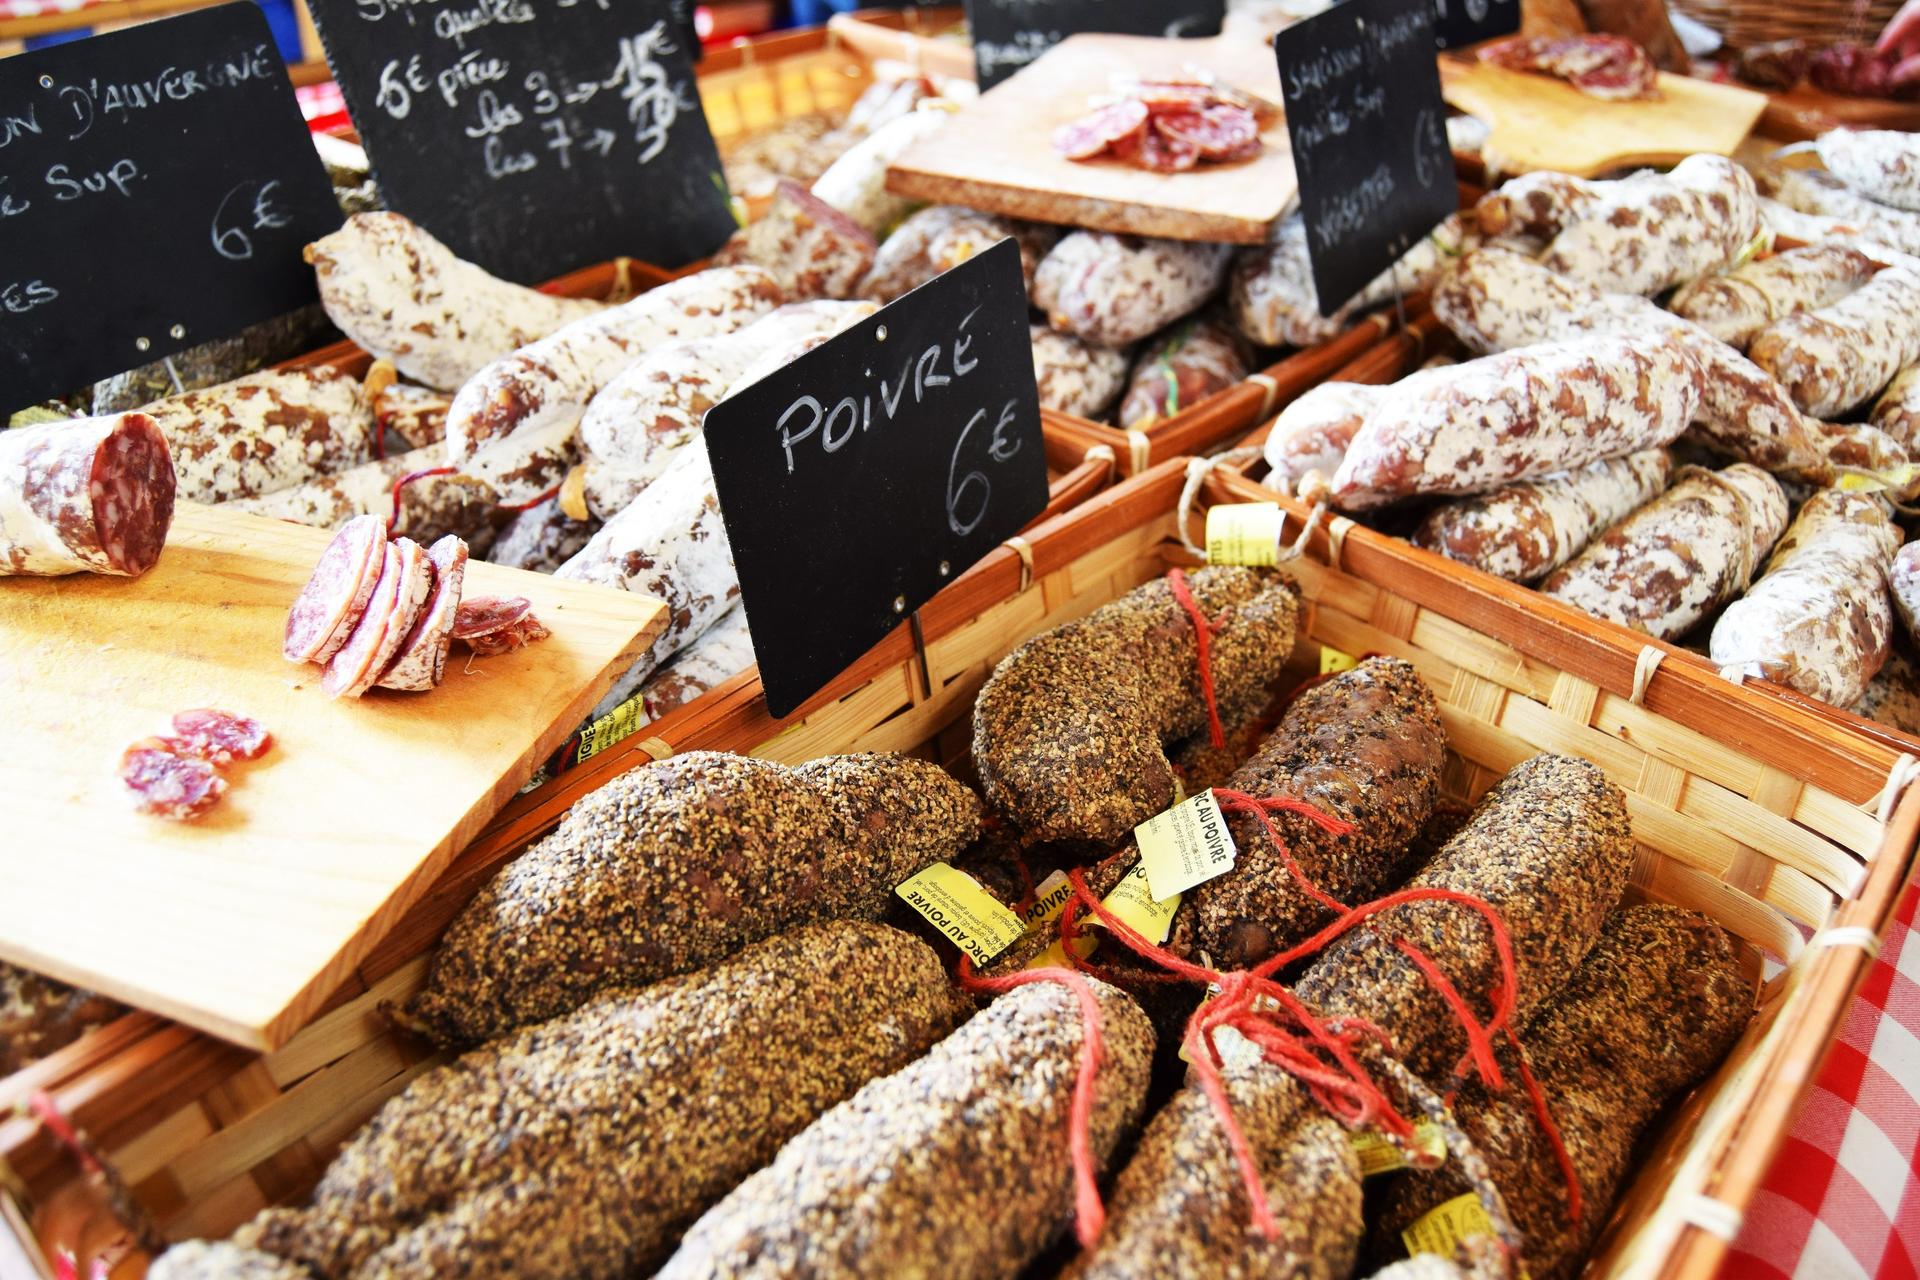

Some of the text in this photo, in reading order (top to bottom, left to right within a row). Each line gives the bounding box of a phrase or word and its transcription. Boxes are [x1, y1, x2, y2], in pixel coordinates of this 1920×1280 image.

[211, 178, 294, 260] 6€
[946, 397, 1022, 537] 6€
[1196, 806, 1214, 823] AU
[1202, 823, 1226, 863] POIVRE
[907, 891, 951, 928] POIVRE
[948, 926, 968, 942] AU
